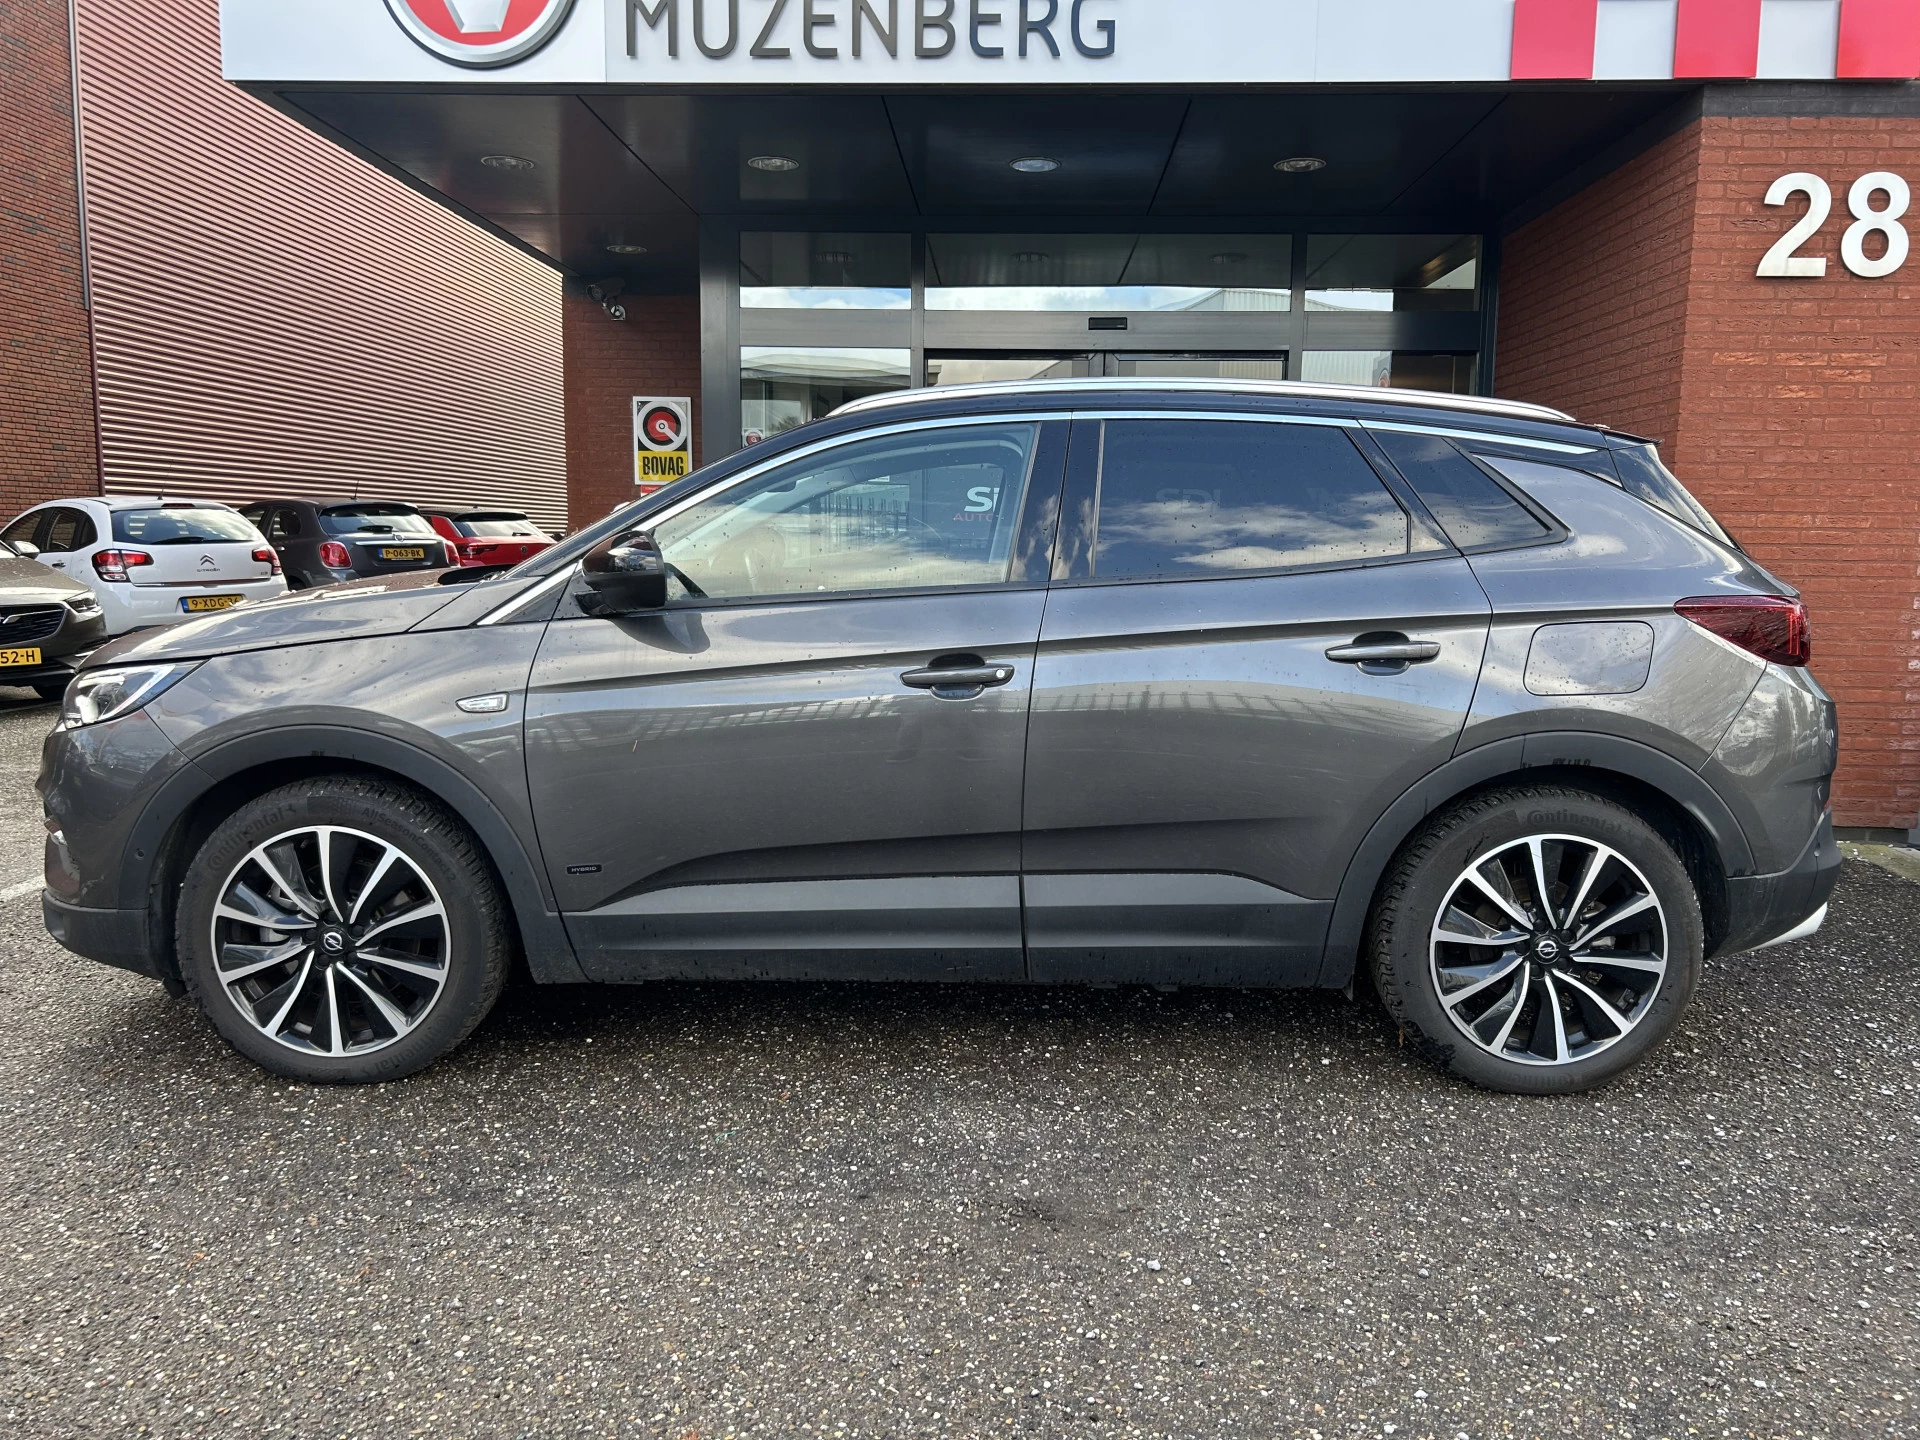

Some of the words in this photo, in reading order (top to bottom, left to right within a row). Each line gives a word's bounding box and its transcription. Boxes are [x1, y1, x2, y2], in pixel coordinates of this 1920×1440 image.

[1756, 171, 1911, 278] 28
[642, 456, 684, 476] BOVAG
[385, 548, 422, 558] P-063-BK
[0, 650, 35, 664] 52-H
[1527, 809, 1623, 833] Continental
[207, 807, 285, 872] Continental
